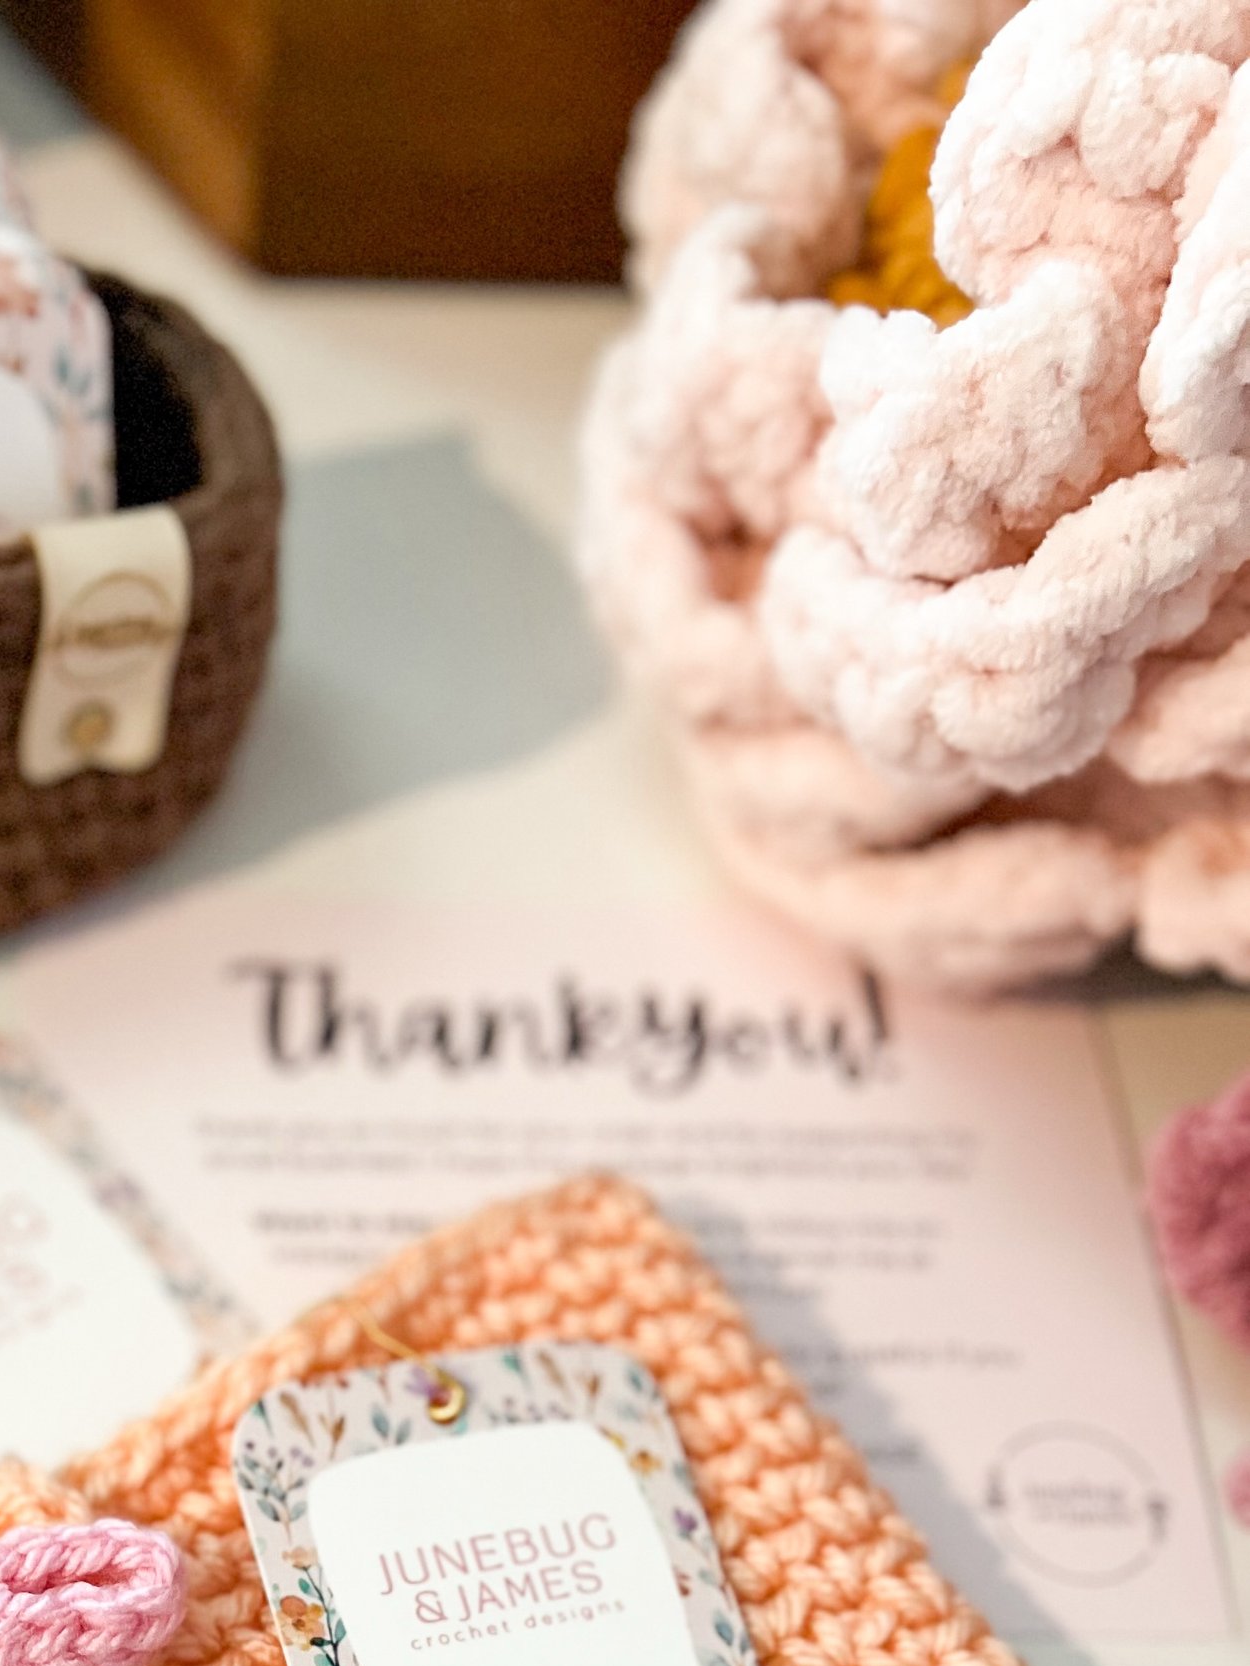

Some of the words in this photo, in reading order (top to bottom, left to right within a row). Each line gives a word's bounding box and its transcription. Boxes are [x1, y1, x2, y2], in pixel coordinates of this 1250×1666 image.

[379, 1512, 617, 1596] JUNEBUG
[458, 1560, 603, 1623] JAMES
[410, 1620, 511, 1651] crochet
[524, 1598, 626, 1630] designs
